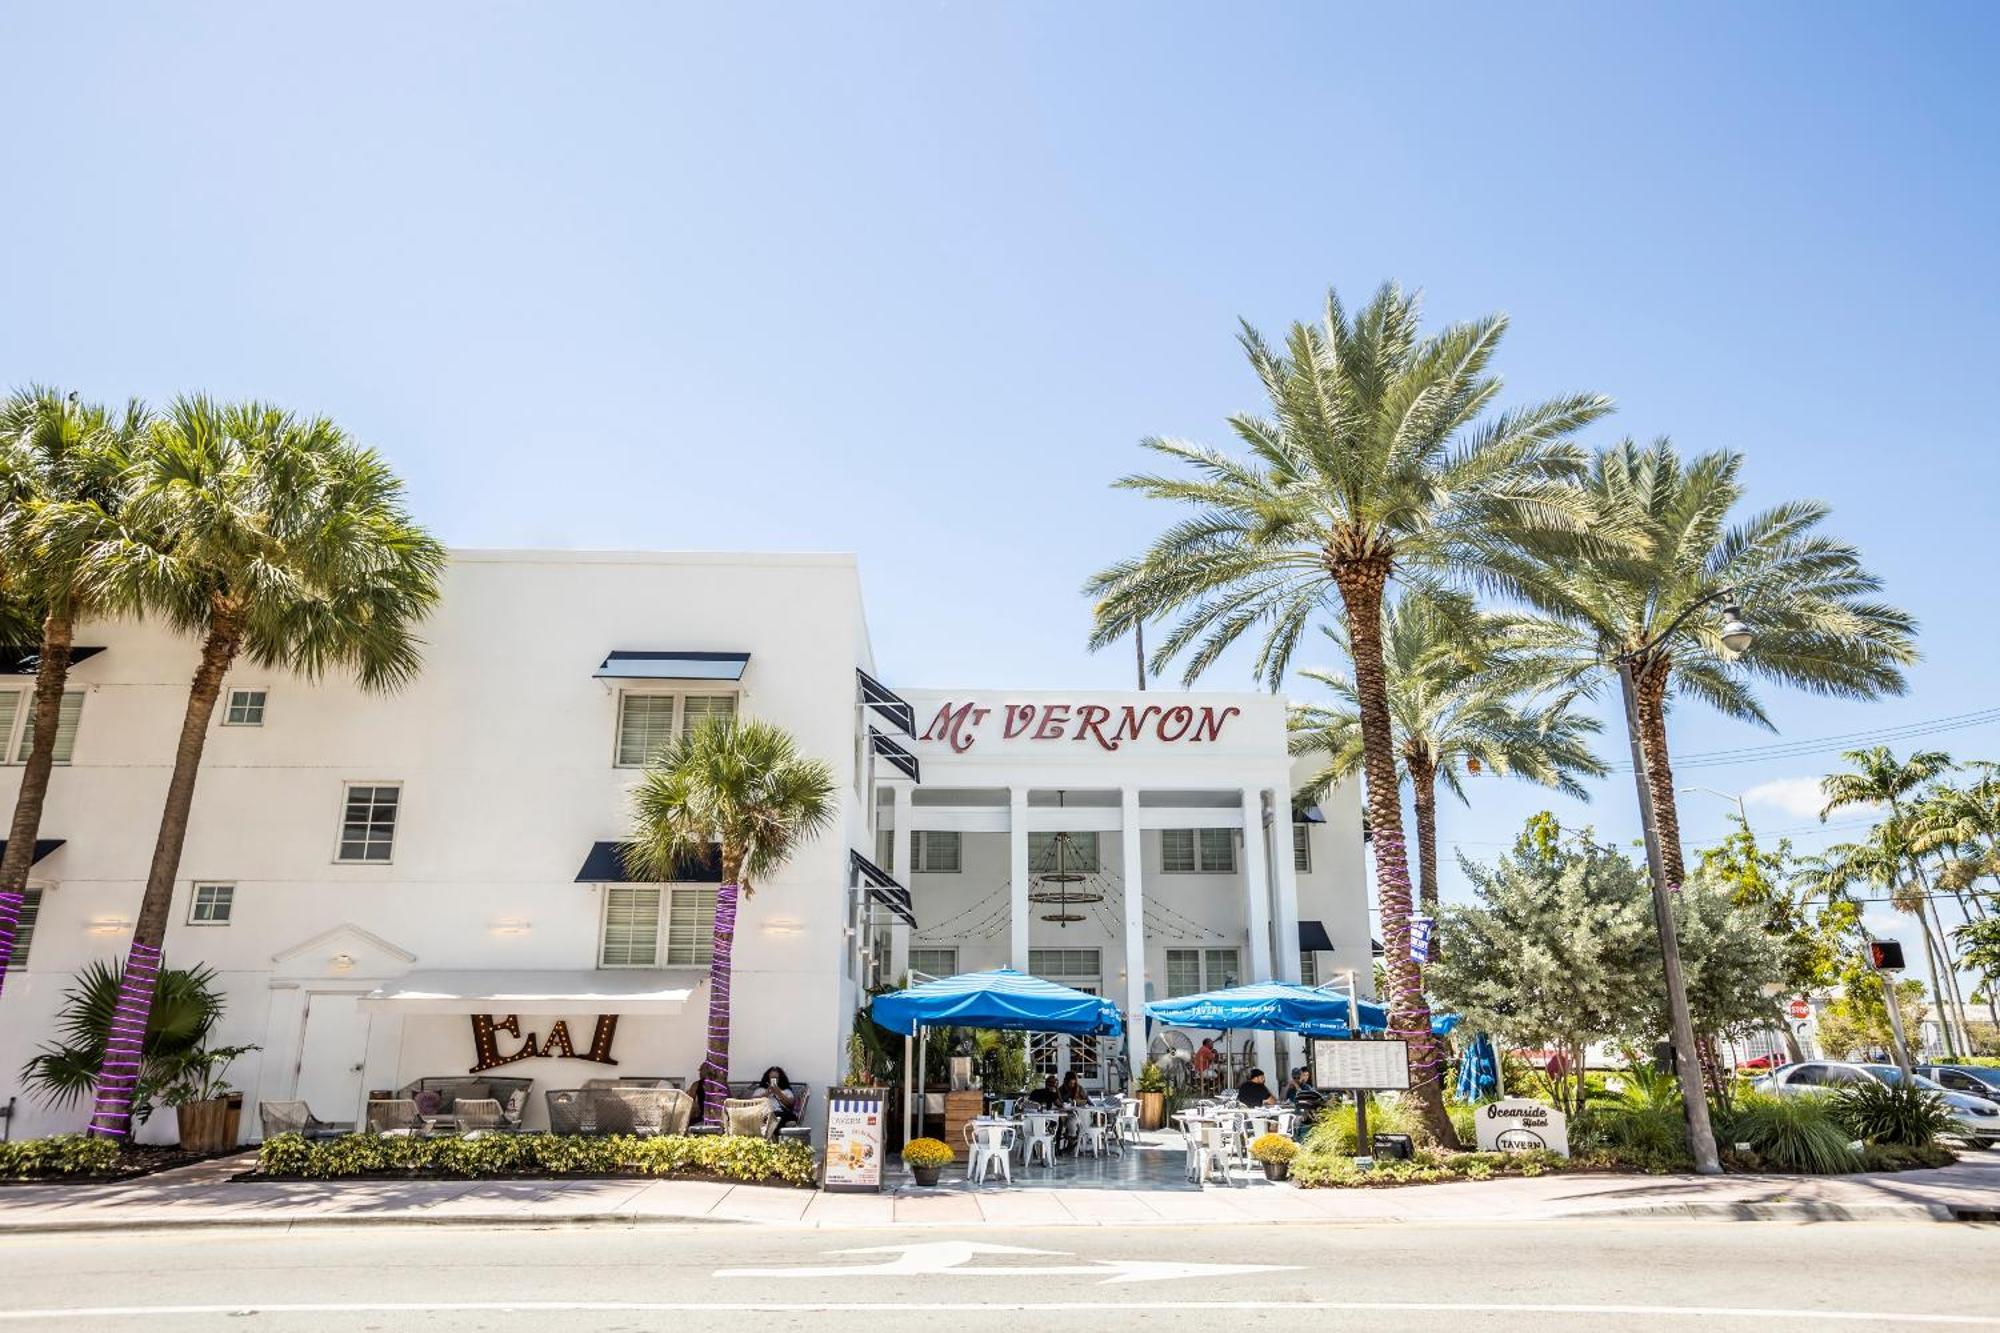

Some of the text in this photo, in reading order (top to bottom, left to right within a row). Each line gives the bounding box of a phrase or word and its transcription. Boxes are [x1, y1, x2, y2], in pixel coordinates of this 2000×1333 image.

[1003, 704, 1240, 751] VERNON
[1191, 1005, 1223, 1015] TAVERN
[1791, 1005, 1809, 1014] STOP
[1487, 1104, 1547, 1119] Oceanside
[1522, 1118, 1548, 1128] Hotel
[1501, 1140, 1541, 1150] TAVERN
